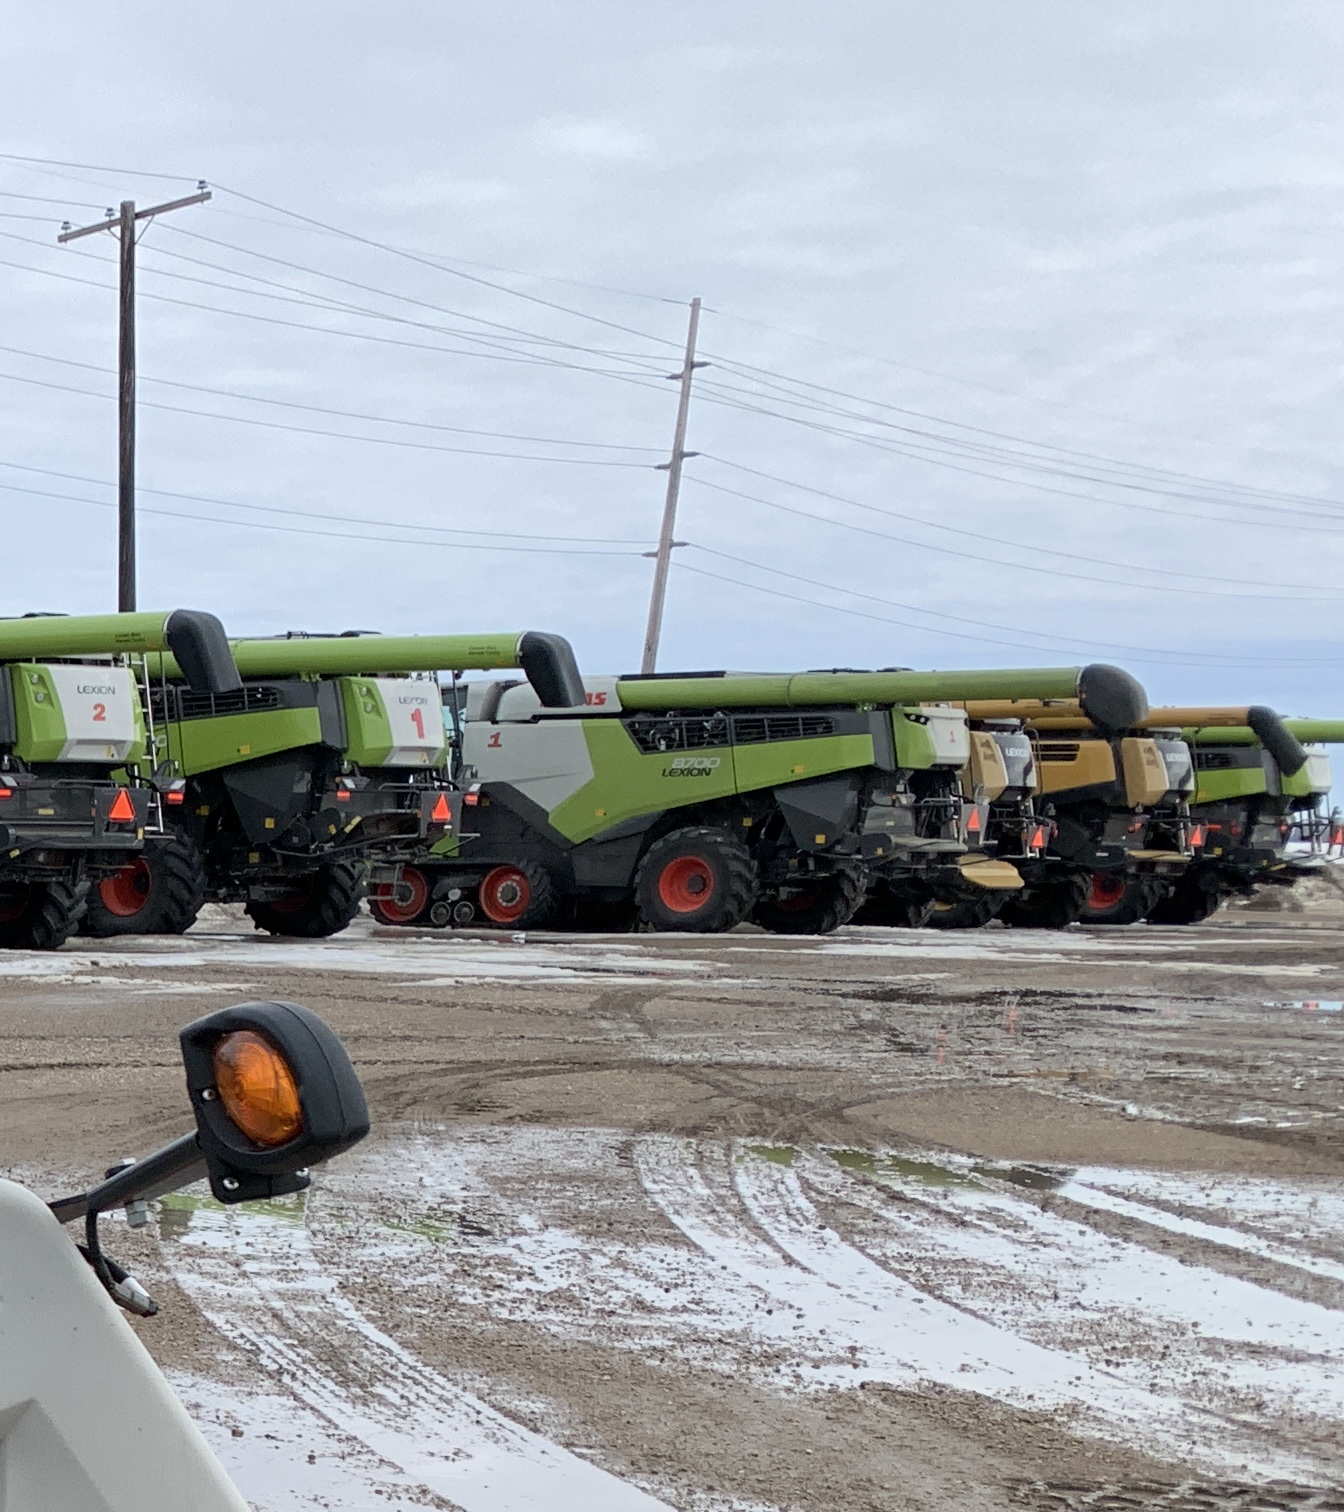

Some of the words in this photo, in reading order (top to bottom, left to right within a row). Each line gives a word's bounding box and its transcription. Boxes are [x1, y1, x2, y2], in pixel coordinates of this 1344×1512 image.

[76, 685, 116, 696] LEXION
[92, 703, 107, 721] 2
[410, 708, 425, 740] 1
[486, 732, 503, 748] 1
[672, 757, 721, 769] 8700
[661, 767, 713, 778] LEXION
